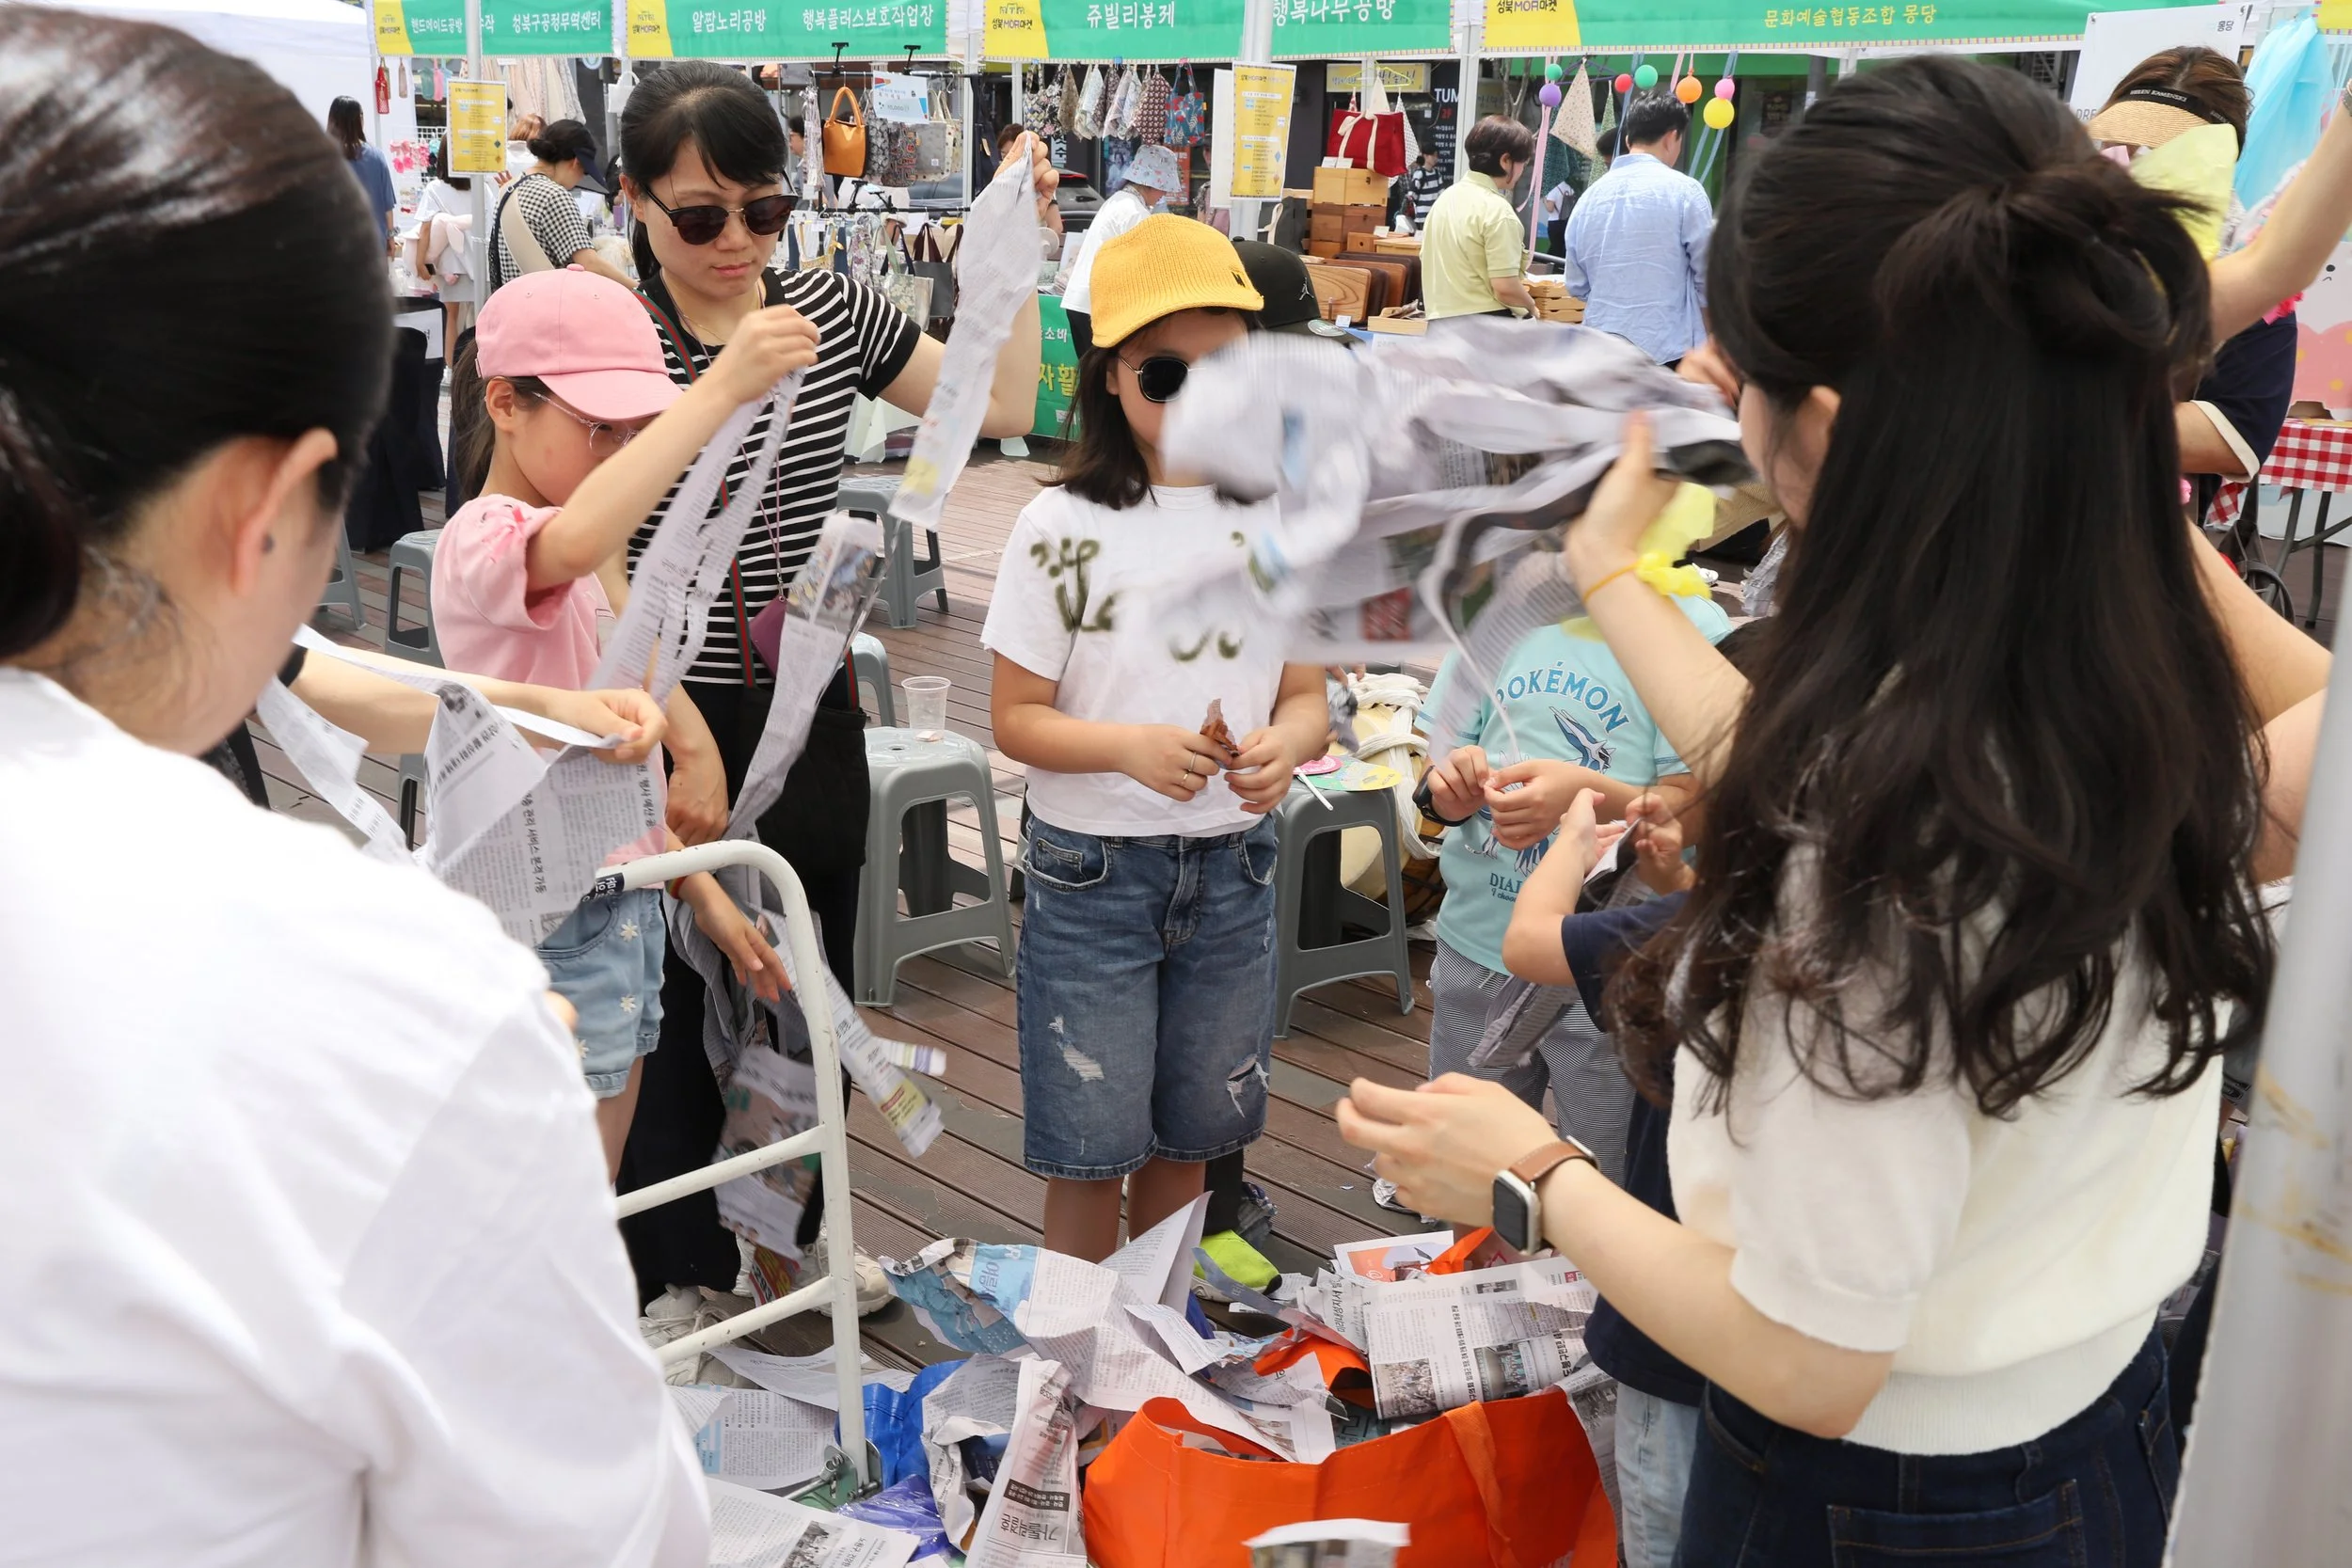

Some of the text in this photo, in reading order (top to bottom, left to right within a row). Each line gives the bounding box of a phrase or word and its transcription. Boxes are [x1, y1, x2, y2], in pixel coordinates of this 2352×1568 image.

[411, 17, 463, 34] 핸드메이드공방
[513, 10, 601, 34] 성북구공정무역센터
[692, 8, 767, 33] 알짬노리공방
[803, 5, 934, 30] 행복플러스보호작업장
[993, 18, 1033, 30] 성북MOA마켓
[1764, 5, 1937, 28] 문화예술협동조합 몽당
[2217, 20, 2234, 32] 몽당
[1000, 1513, 1058, 1542] 가톨릭결혼
